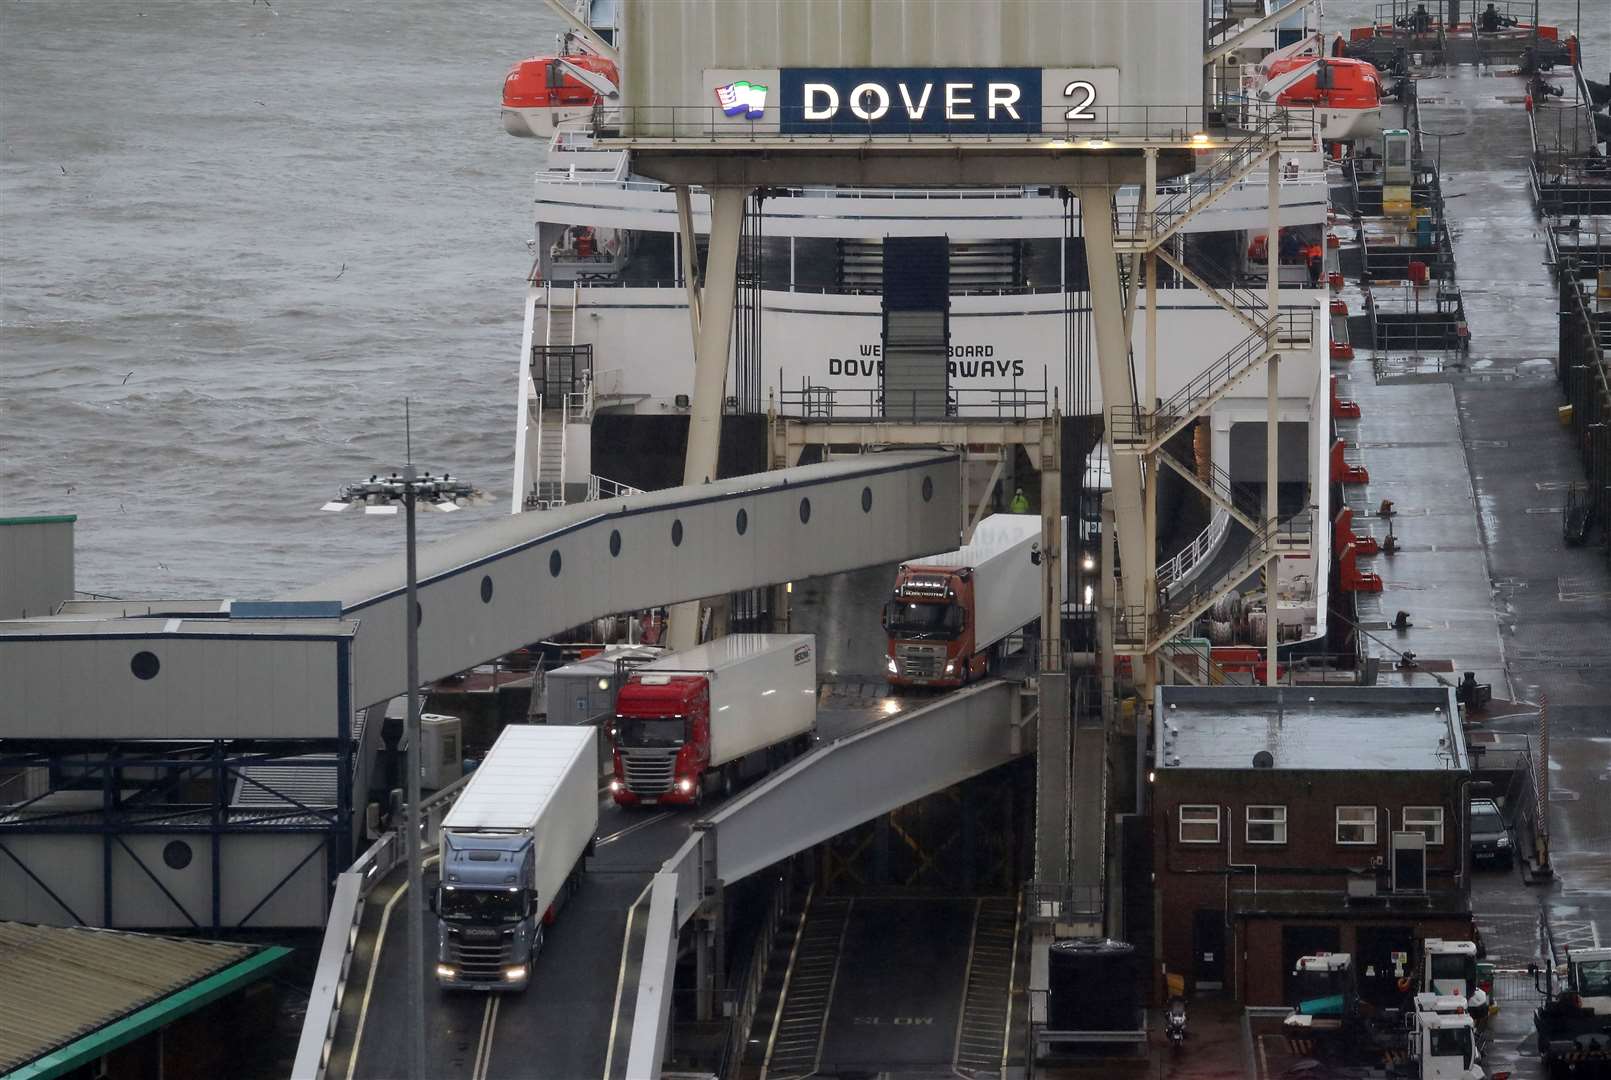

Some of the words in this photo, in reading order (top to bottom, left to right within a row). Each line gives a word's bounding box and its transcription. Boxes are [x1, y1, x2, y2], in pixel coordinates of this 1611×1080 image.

[803, 82, 1022, 120] DOVER
[1063, 80, 1097, 121] 2
[853, 1016, 935, 1026] SLOW
